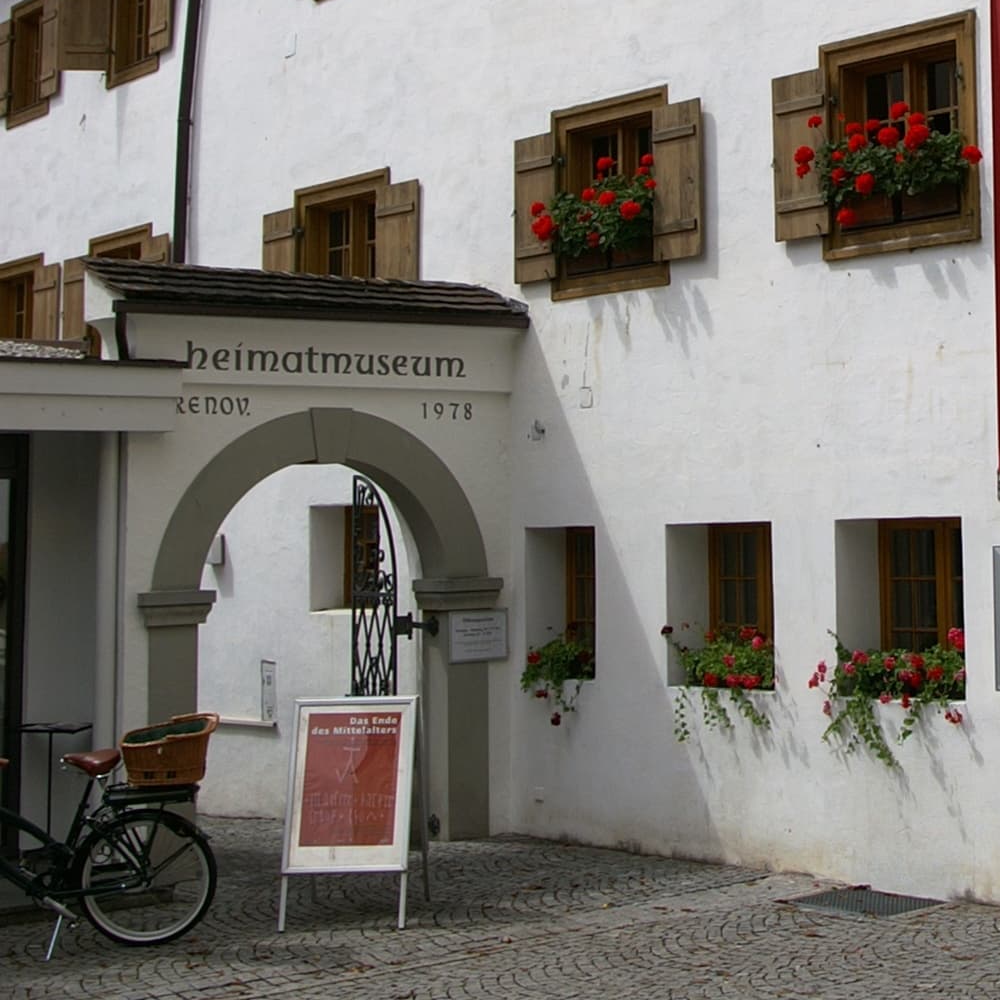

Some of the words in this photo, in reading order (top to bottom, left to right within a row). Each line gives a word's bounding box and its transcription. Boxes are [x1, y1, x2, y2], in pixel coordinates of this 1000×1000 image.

[186, 340, 467, 378] heimatmuseum
[421, 402, 473, 420] 1978
[350, 716, 368, 725] Das
[372, 716, 397, 725] Ende
[312, 726, 330, 735] des
[333, 725, 397, 735] Mittelalters
